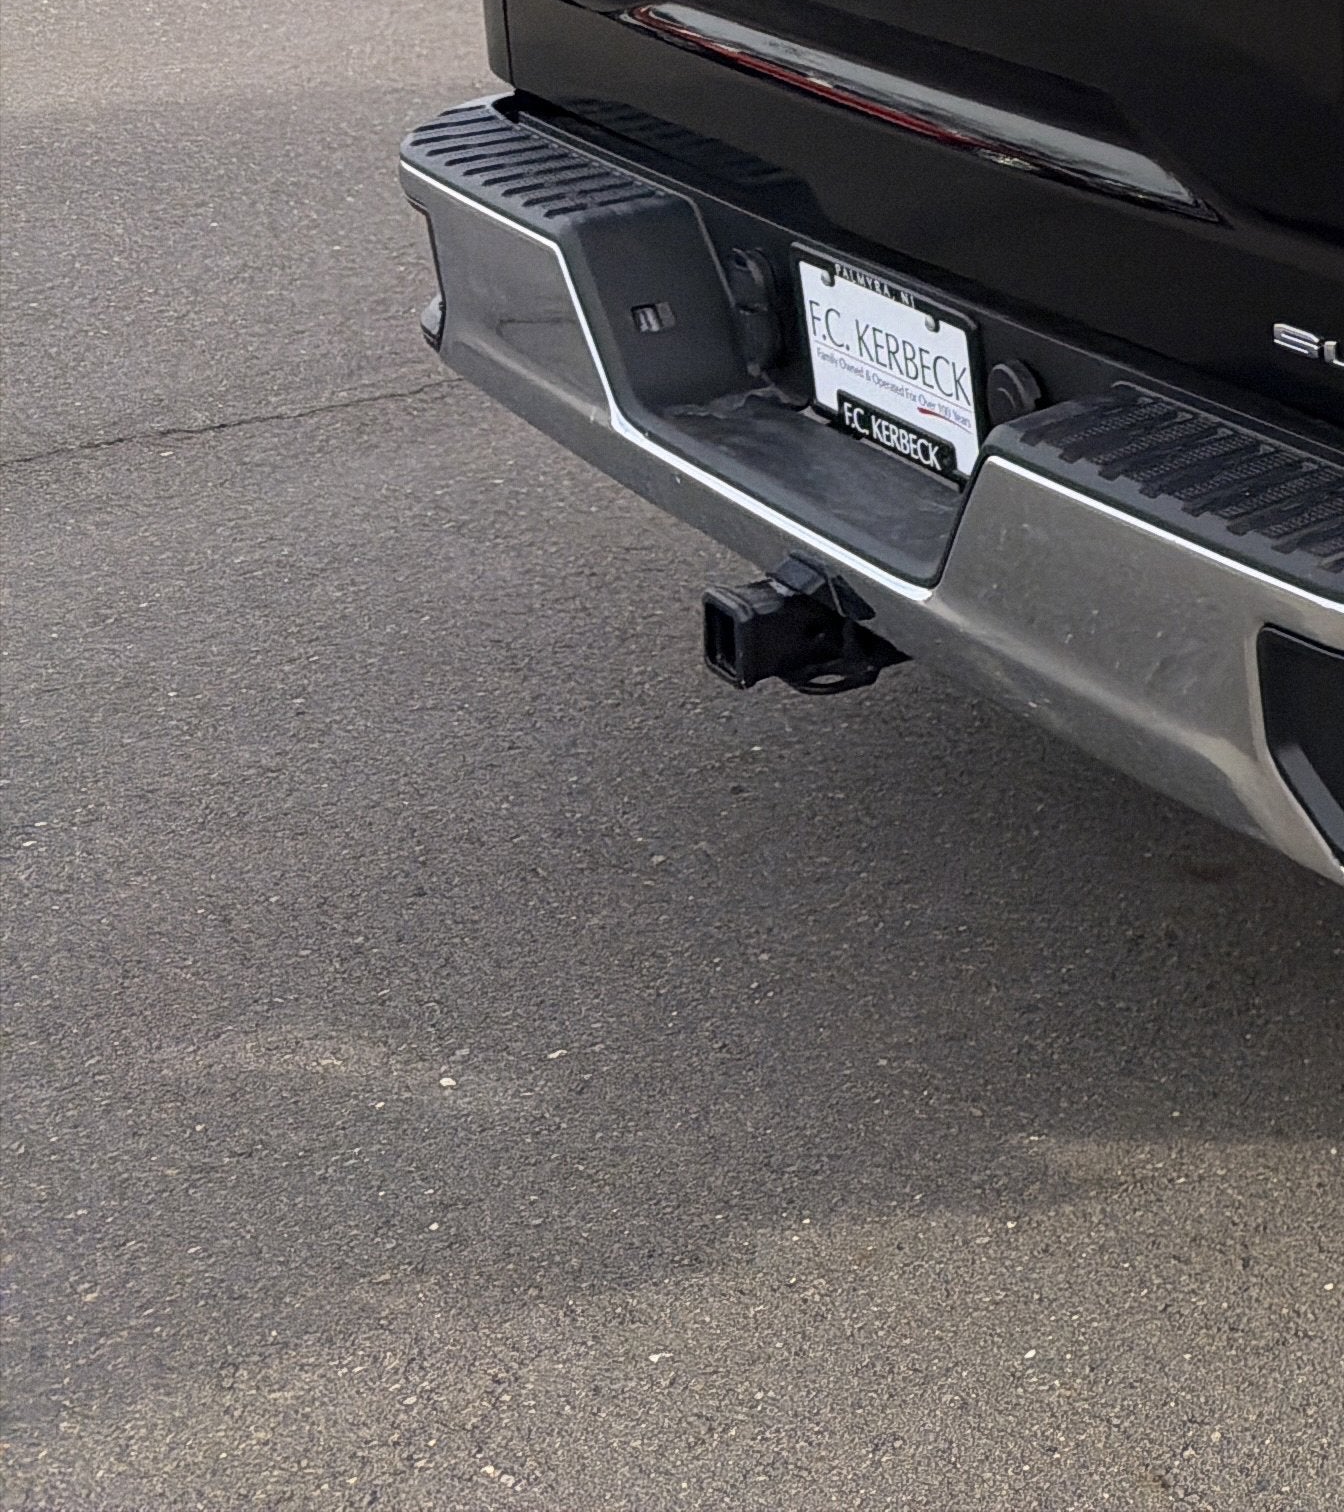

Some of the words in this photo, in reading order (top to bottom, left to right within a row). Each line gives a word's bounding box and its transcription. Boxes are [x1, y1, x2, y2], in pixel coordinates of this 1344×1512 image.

[809, 299, 850, 351] F.C.
[856, 319, 971, 406] KERBECK
[871, 414, 942, 471] KERBECK
